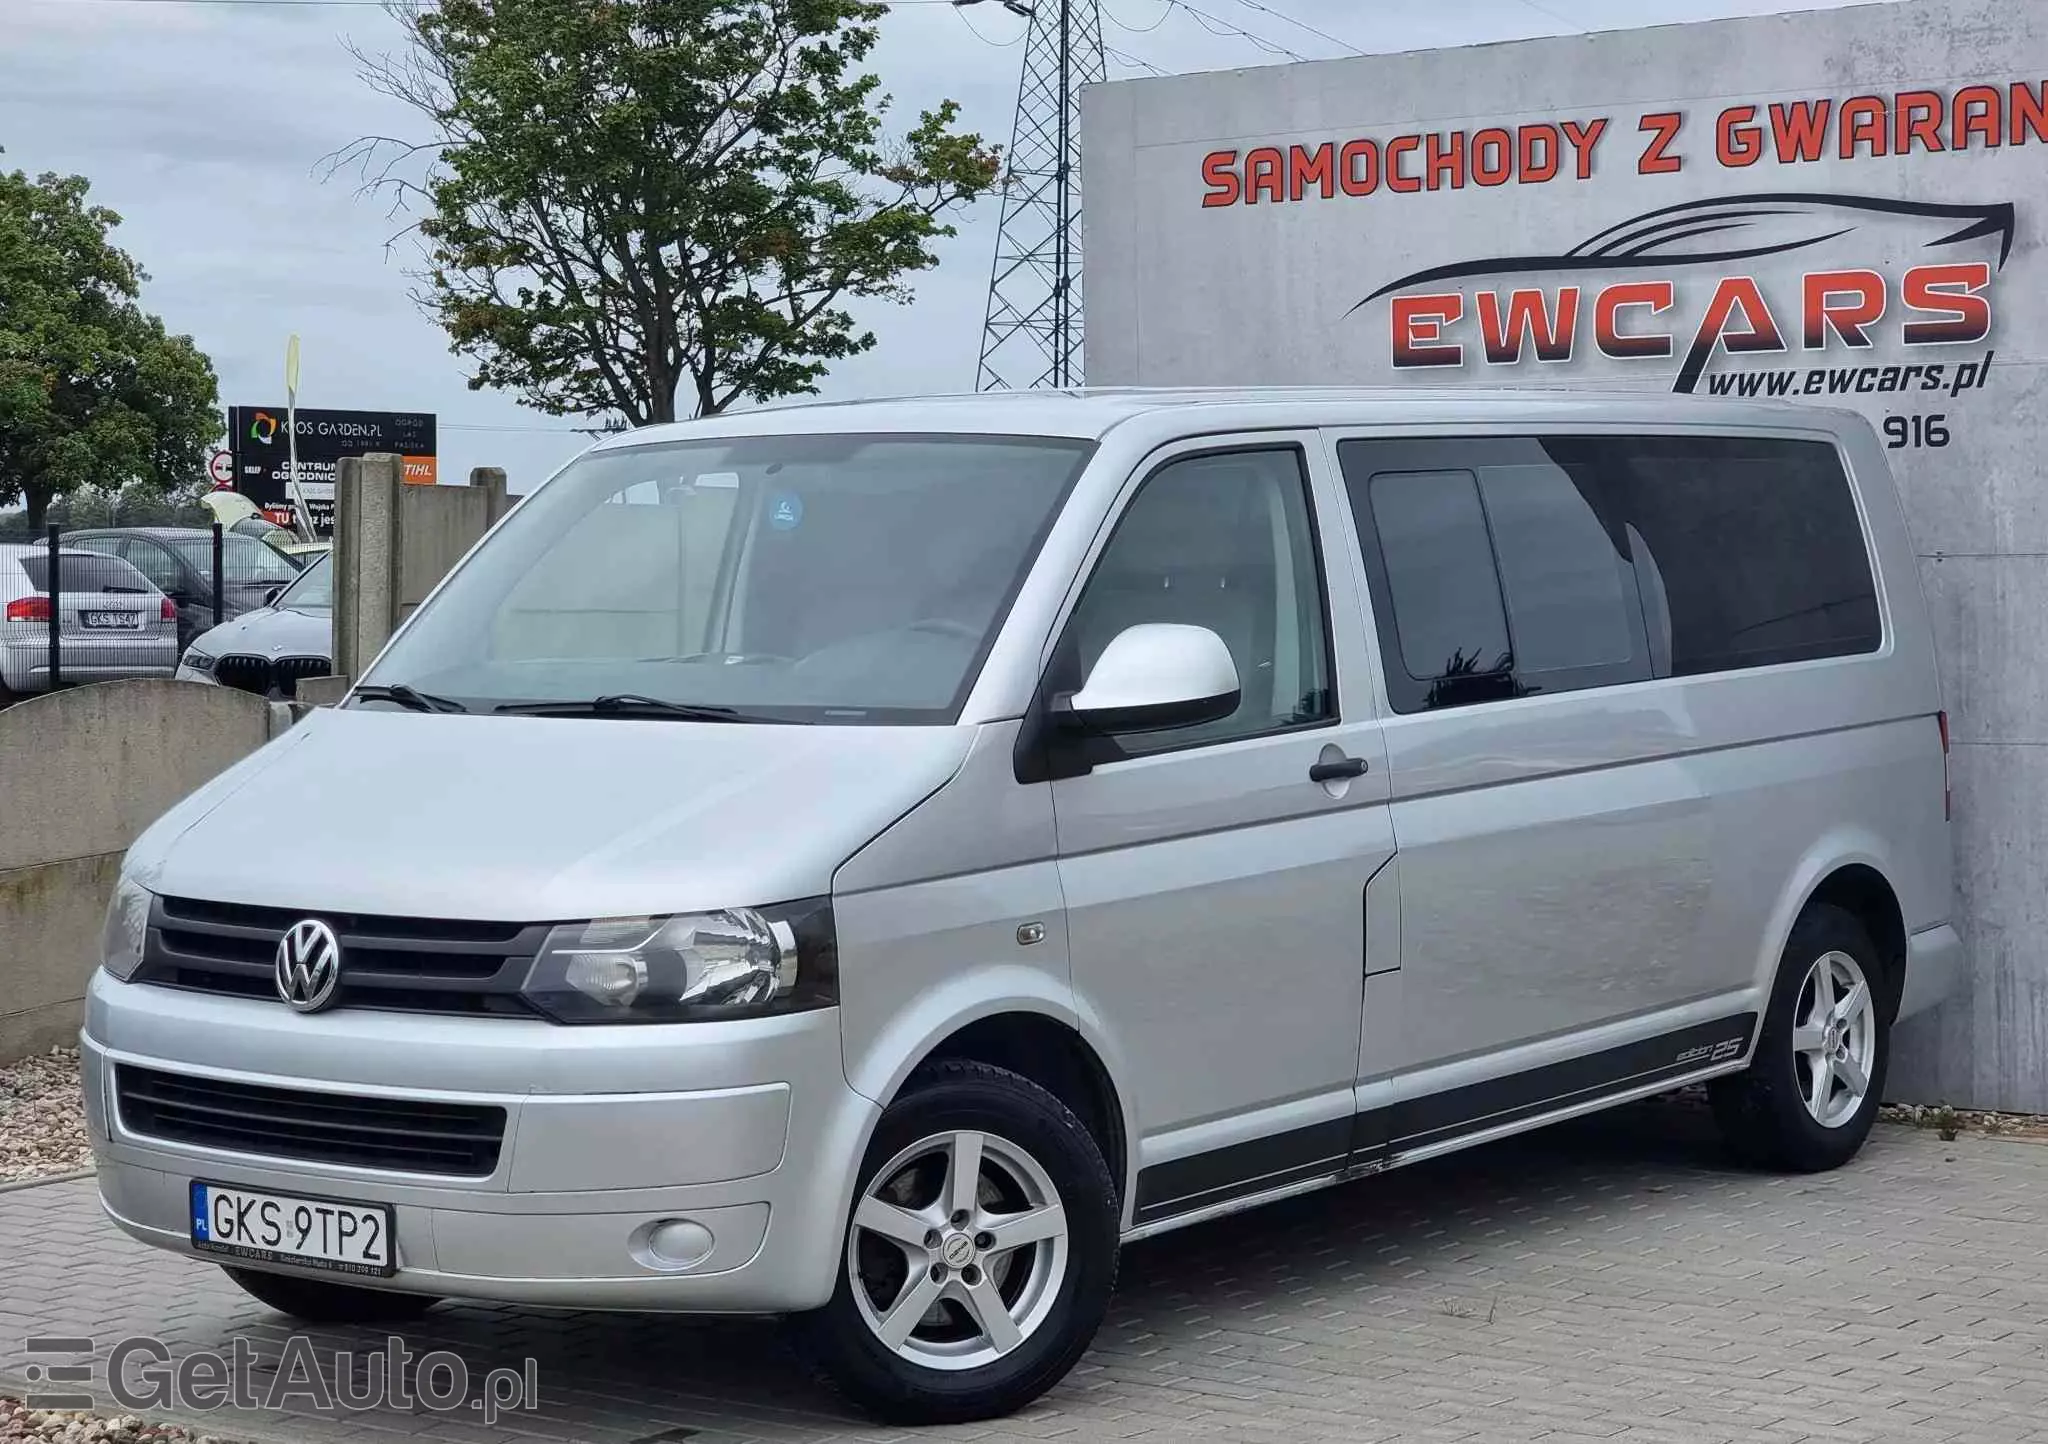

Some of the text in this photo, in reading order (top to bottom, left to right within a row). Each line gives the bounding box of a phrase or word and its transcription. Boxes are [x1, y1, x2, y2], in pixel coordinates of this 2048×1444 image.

[1201, 80, 2048, 209] SAMOCHODY Z GWARAN
[1390, 262, 1991, 393] EWCARS
[1709, 350, 1995, 398] www.ewcars.pl
[318, 422, 382, 437] GARDEN.PL
[1883, 414, 1950, 449] 916
[196, 1219, 208, 1232] PL
[214, 1193, 381, 1261] GKS 9TP2
